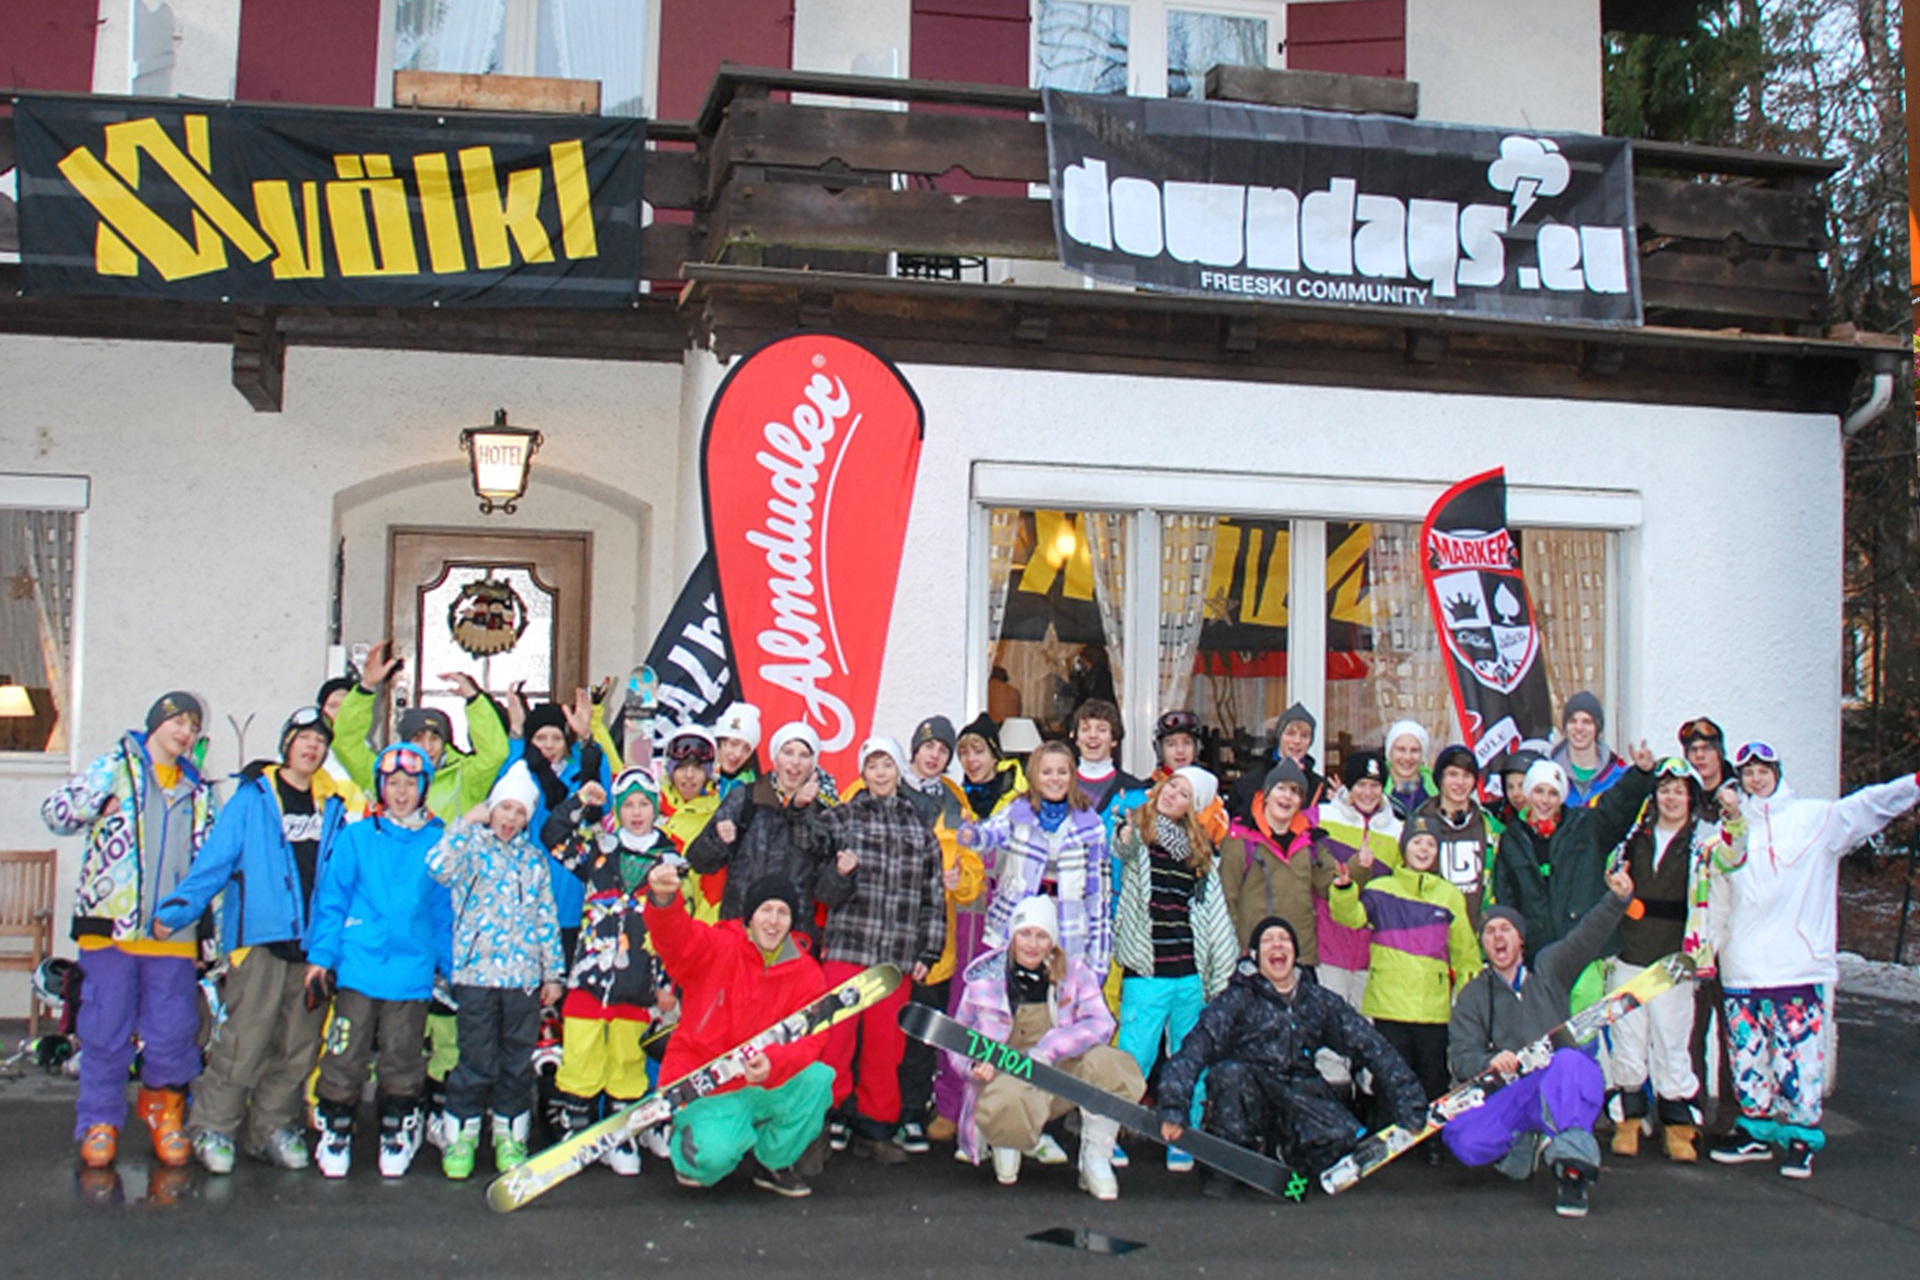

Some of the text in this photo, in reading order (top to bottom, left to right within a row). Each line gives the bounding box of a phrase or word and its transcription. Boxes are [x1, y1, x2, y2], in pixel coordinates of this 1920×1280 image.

[252, 139, 598, 280] völkl
[1201, 270, 1429, 306] FREESKI COMMUNITY
[478, 444, 523, 466] HOTEL
[745, 373, 856, 754] Almdudler
[1430, 530, 1510, 566] MARKER
